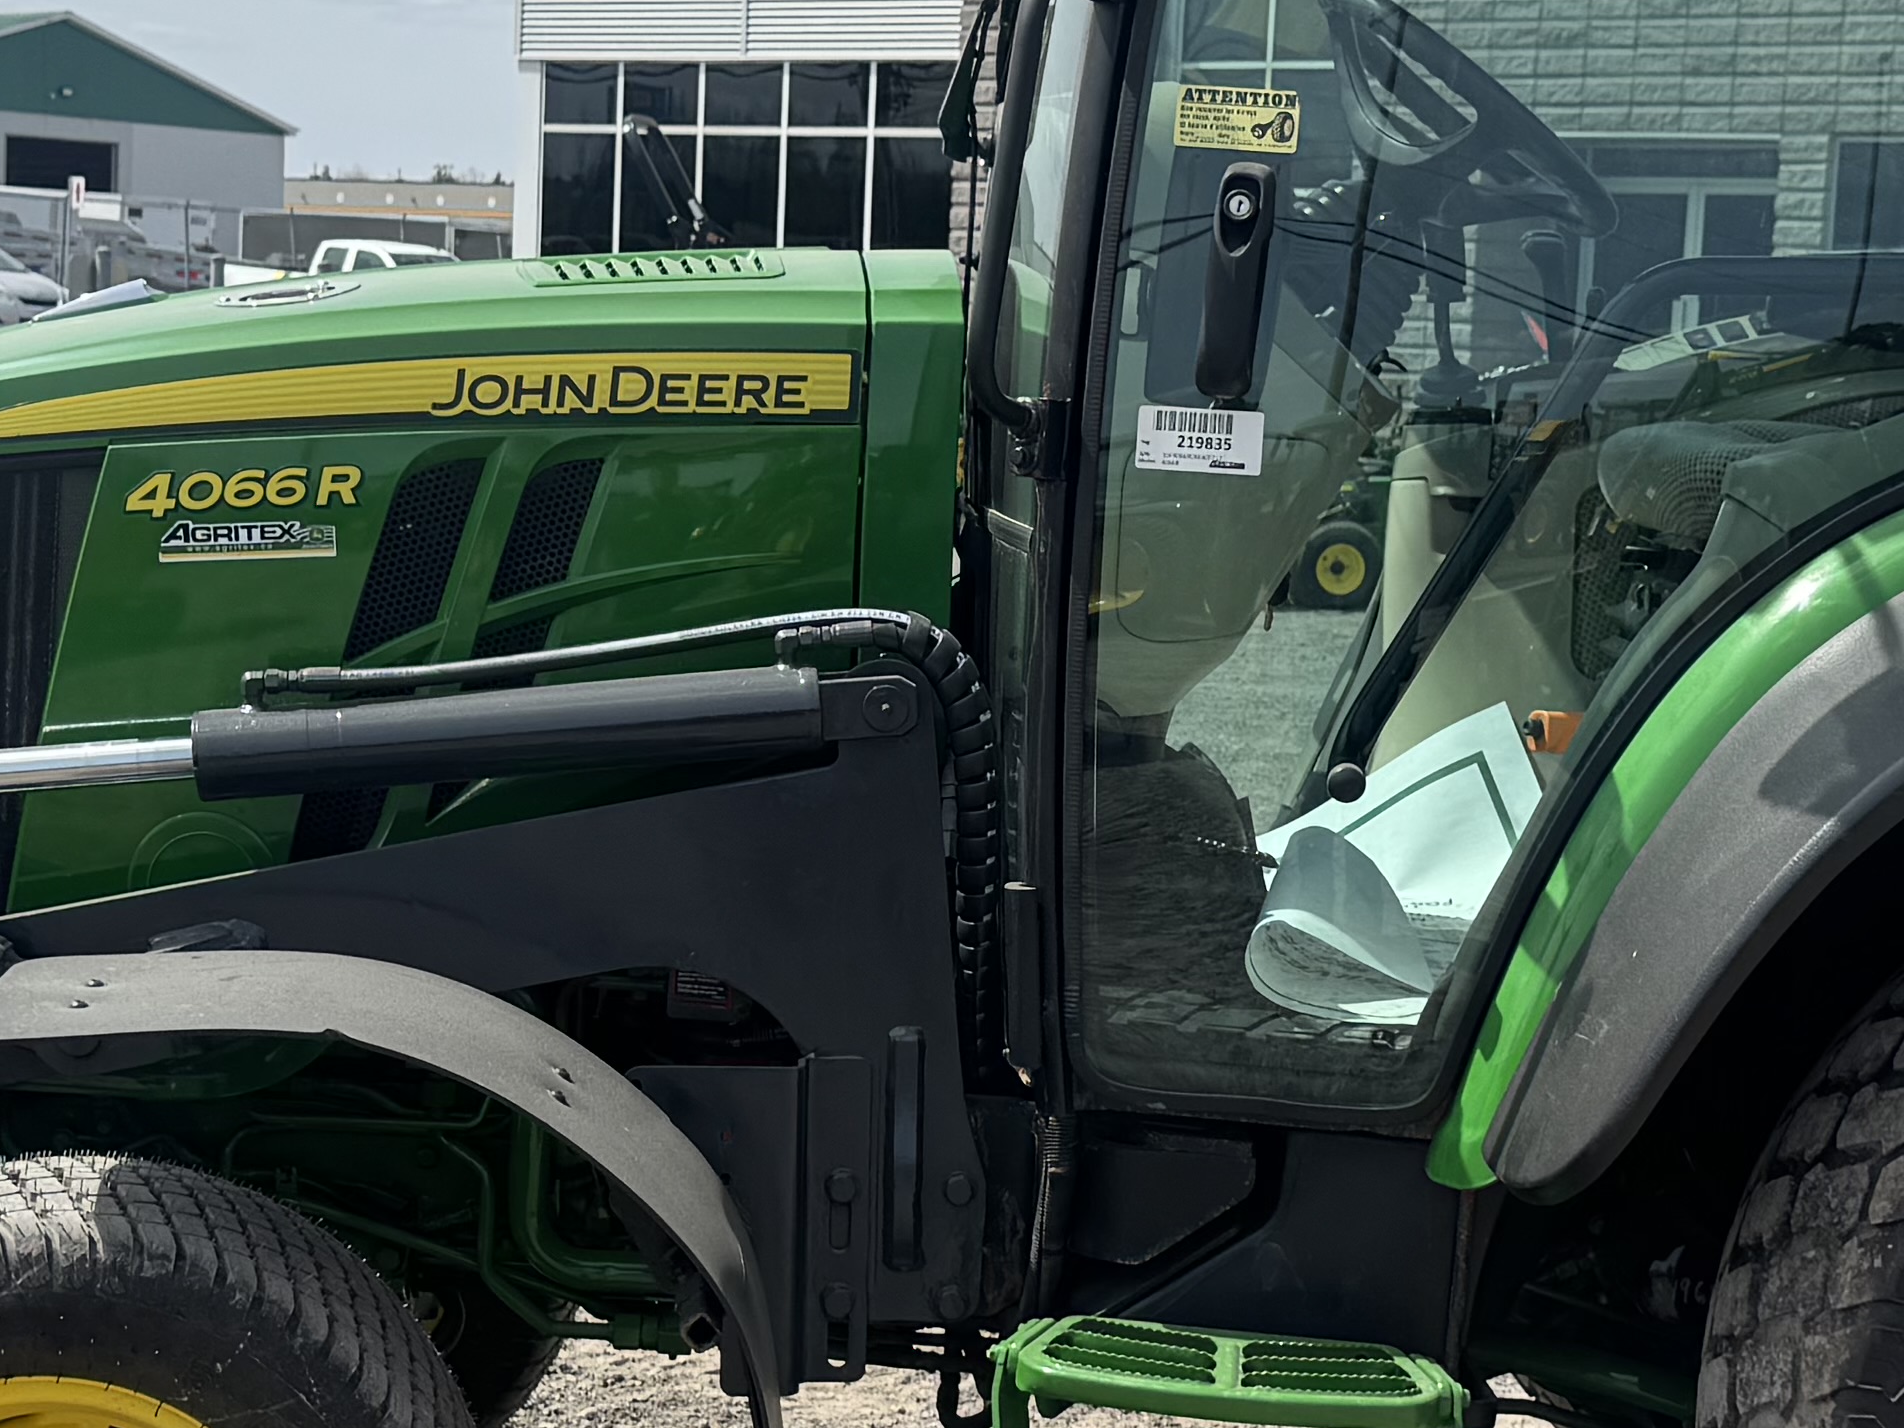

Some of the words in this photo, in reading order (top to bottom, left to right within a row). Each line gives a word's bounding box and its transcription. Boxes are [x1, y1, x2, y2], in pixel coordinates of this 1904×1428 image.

[1182, 88, 1298, 108] ATTENTION
[432, 368, 596, 410] JOHN
[608, 365, 809, 409] DEERE
[1177, 435, 1232, 450] 219835
[162, 522, 299, 543] AGRITEX
